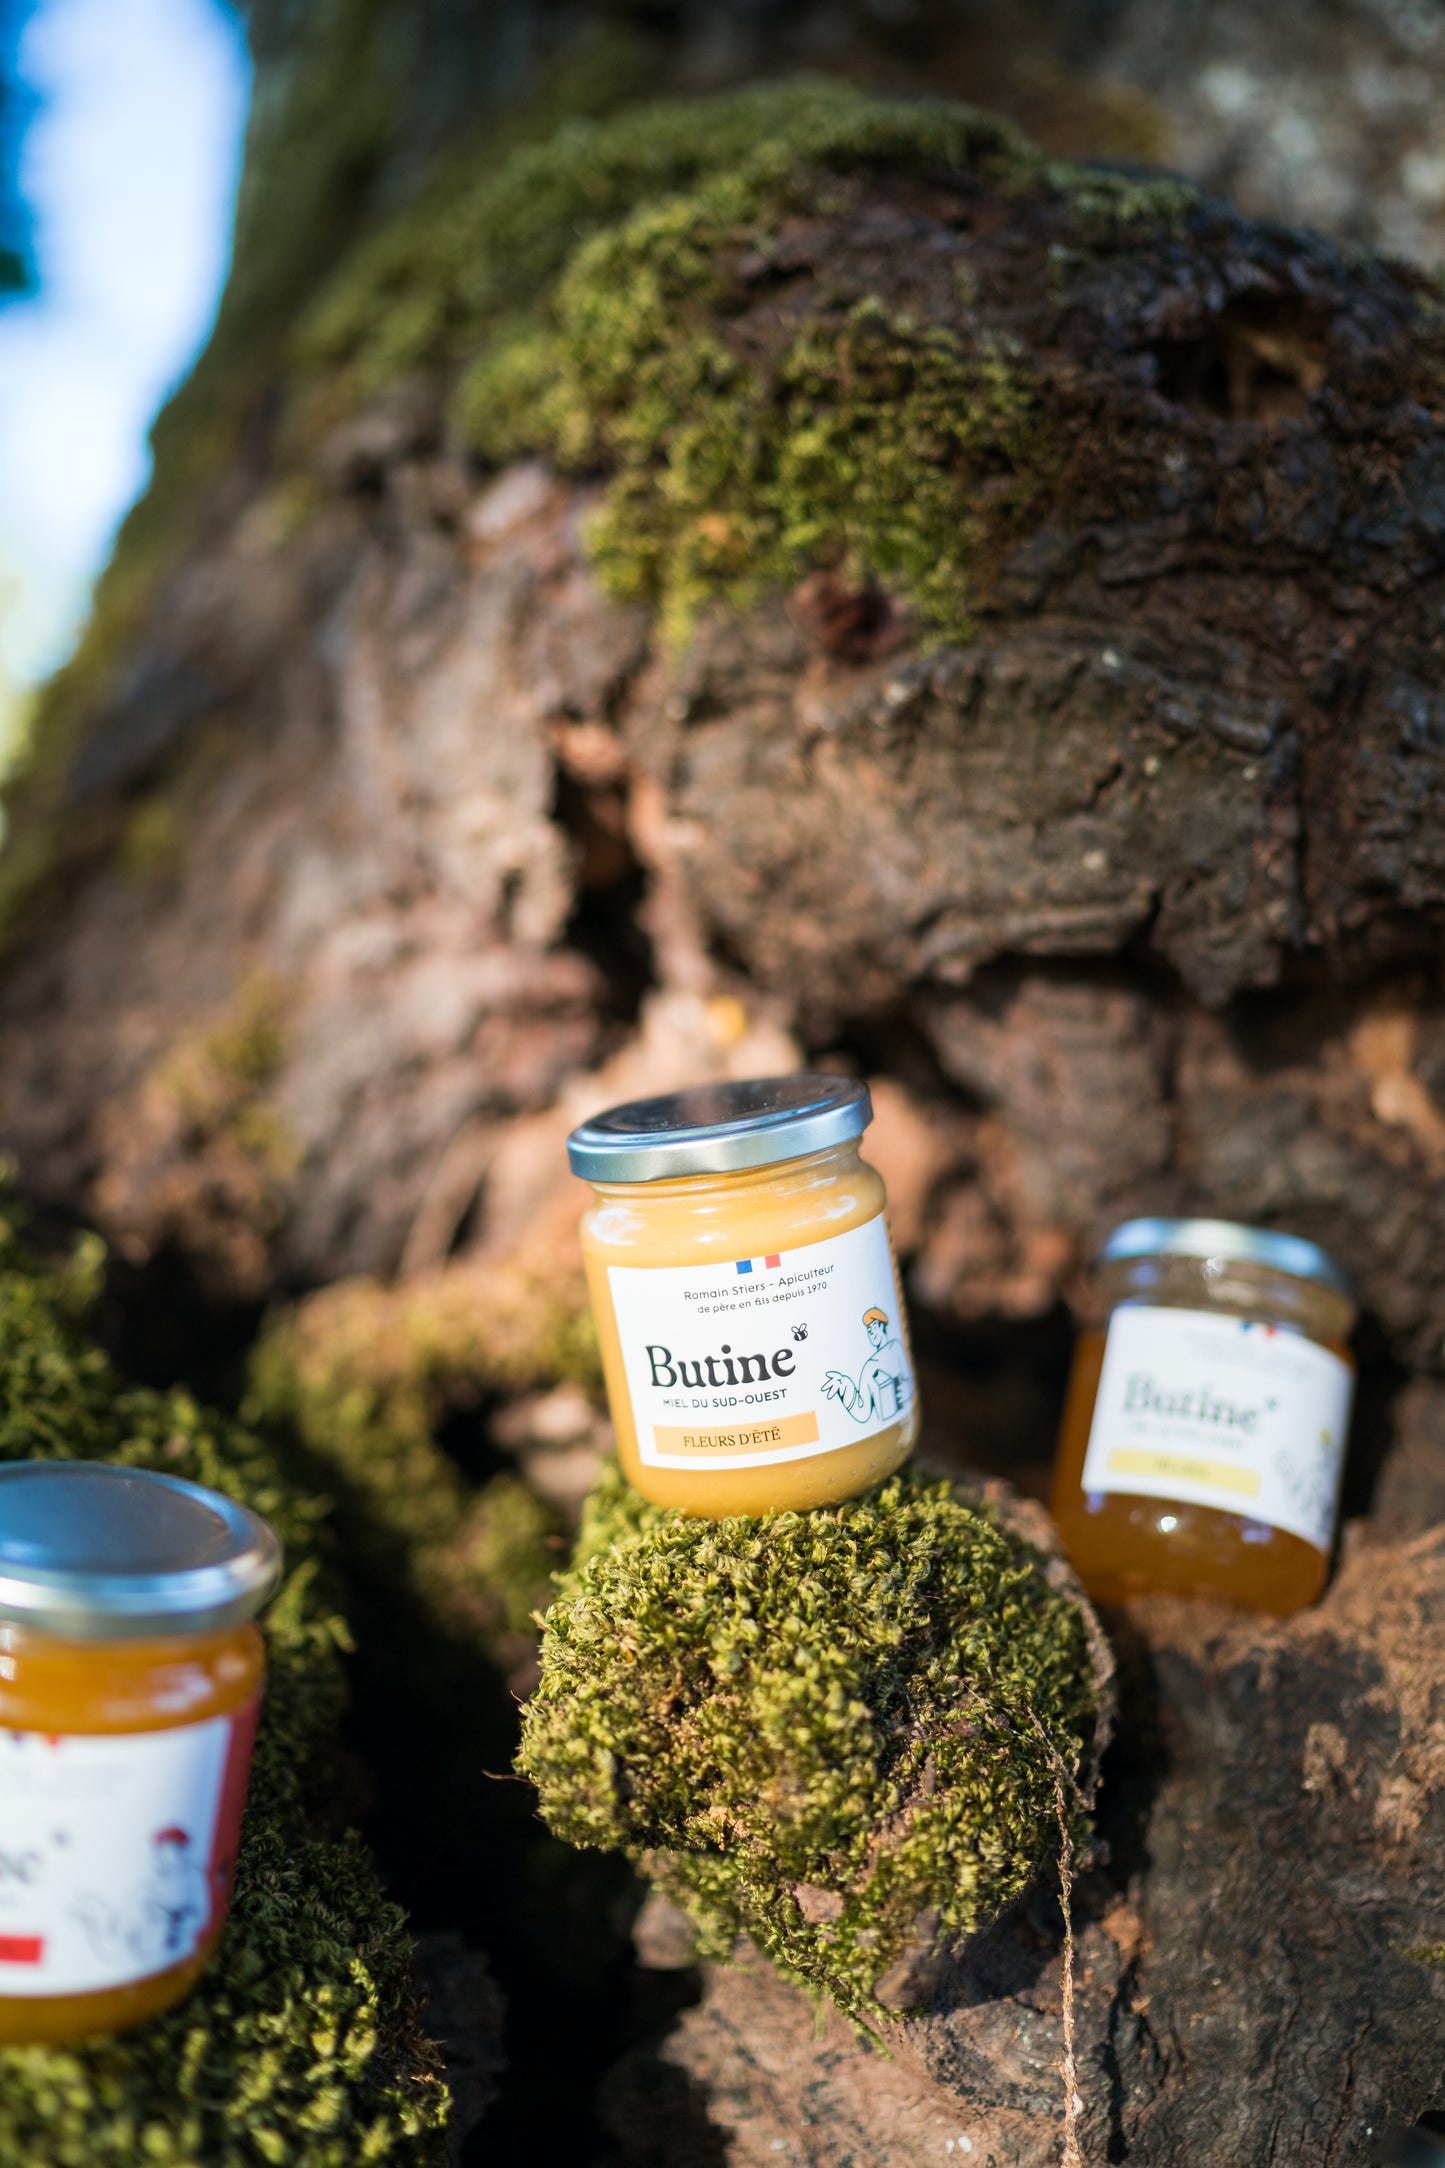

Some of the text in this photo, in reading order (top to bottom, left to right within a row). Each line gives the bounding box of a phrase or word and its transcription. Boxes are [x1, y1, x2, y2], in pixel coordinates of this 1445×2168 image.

[684, 1288, 729, 1301] Romain
[732, 1282, 766, 1296] Stiers
[778, 1264, 835, 1287] Apiculteur
[697, 1281, 828, 1314] de père en fils depuis 1970
[645, 1344, 796, 1388] Butine
[663, 1388, 788, 1408] MIEL DU SUD-OUEST
[1122, 1372, 1259, 1435] Butine
[683, 1435, 736, 1448] FLEURS
